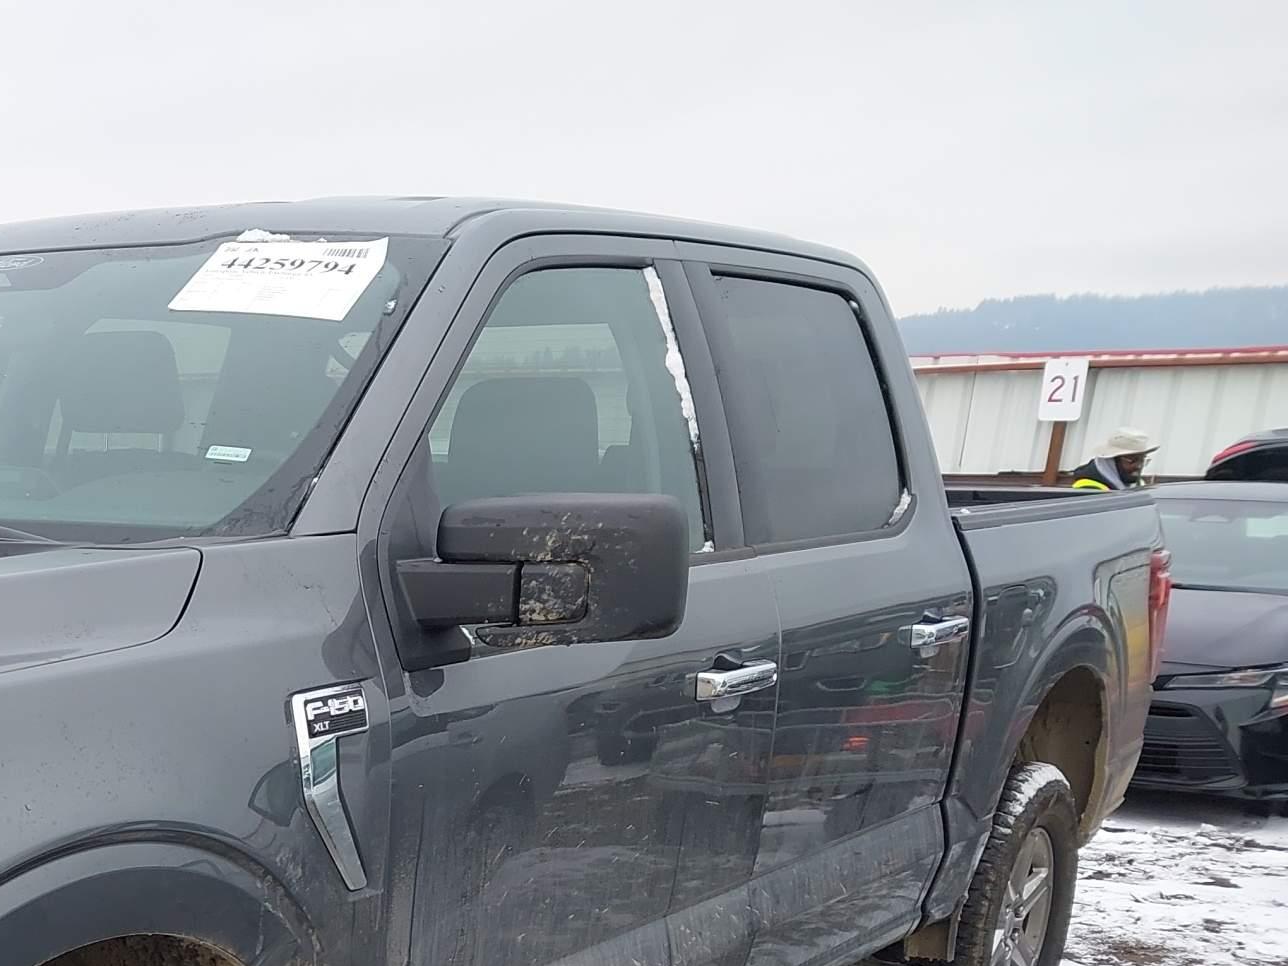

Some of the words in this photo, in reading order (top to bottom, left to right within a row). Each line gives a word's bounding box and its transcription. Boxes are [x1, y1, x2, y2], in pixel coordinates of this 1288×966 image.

[220, 256, 357, 276] 44259794
[1047, 374, 1080, 403] 21
[305, 695, 365, 720] F-150
[313, 721, 330, 733] XLT
